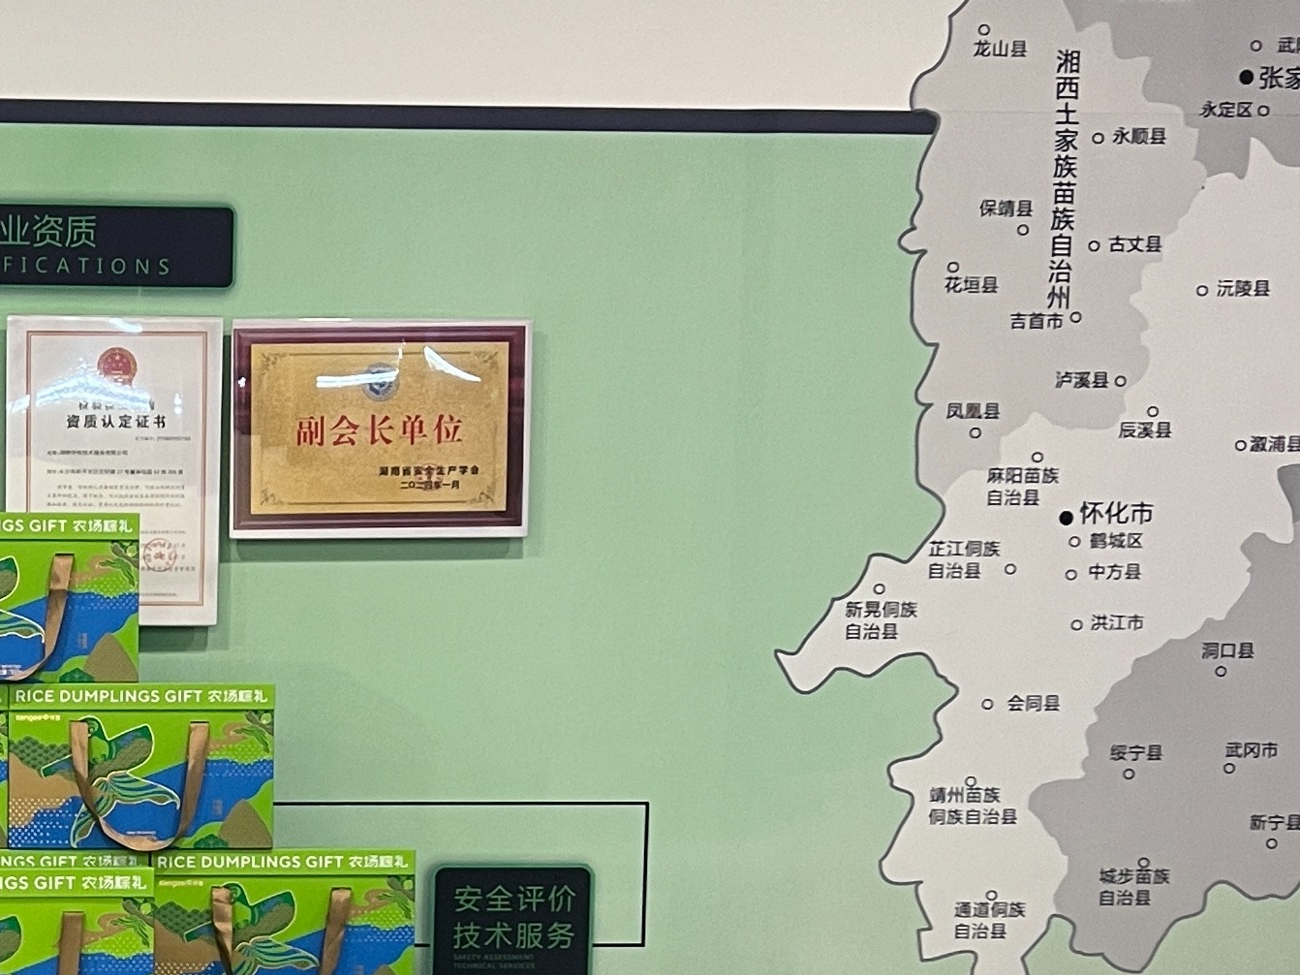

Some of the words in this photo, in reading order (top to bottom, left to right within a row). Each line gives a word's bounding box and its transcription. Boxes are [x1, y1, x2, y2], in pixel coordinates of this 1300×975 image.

[974, 40, 1027, 57] 龙山县
[1276, 37, 1300, 53] 武
[1200, 102, 1252, 117] 永定区
[1112, 127, 1166, 145] 永顺县
[1047, 49, 1080, 309] 湘西土家族苗族自治州
[979, 200, 1033, 217] 保靖县
[1109, 236, 1161, 253] 古丈县
[945, 277, 998, 294] 花垣县
[1217, 281, 1269, 297] 沅陵县
[1010, 313, 1063, 330] 吉首市
[1056, 372, 1109, 389] 泸溪县
[947, 403, 1000, 419] 凤凰县
[64, 414, 167, 430] 资质认定证书
[296, 414, 463, 447] 副会长单位
[1119, 422, 1171, 439] 辰溪县
[988, 468, 1059, 484] 麻阳苗族
[987, 489, 1040, 506] 自治县
[1080, 502, 1153, 524] 怀化市
[28, 519, 68, 533] GIFT
[929, 541, 1000, 557] 芷江侗族
[1089, 533, 1143, 549] 鹤城区
[928, 563, 981, 579] 自治县
[1089, 564, 1141, 580] 中方县
[845, 601, 918, 618] 新晃侗族
[1091, 615, 1143, 631] 洪江市
[845, 623, 898, 640] 自治县
[1202, 642, 1254, 659] 洞口县
[15, 689, 55, 703] RICE
[59, 689, 160, 703] DUMPLINGS
[164, 689, 203, 703] GIFT
[1007, 695, 1060, 712] 会同县
[1110, 744, 1162, 761] 绥宁县
[1225, 742, 1278, 758] 武冈市
[929, 787, 1000, 803] 靖州苗族
[929, 809, 1017, 825] 侗族自治县
[1250, 815, 1300, 831] 新宁县
[157, 855, 196, 869] RICE
[201, 855, 301, 869] DUMPLINGS
[305, 855, 344, 869] GIFT
[33, 875, 76, 890] GIFT
[1099, 868, 1170, 885] 城步苗族
[454, 885, 576, 913] 安全评价
[1099, 890, 1151, 906] 自治县
[954, 902, 1025, 918] 通道侗族
[453, 921, 575, 949] 技术服务
[954, 923, 1006, 940] 自治县
